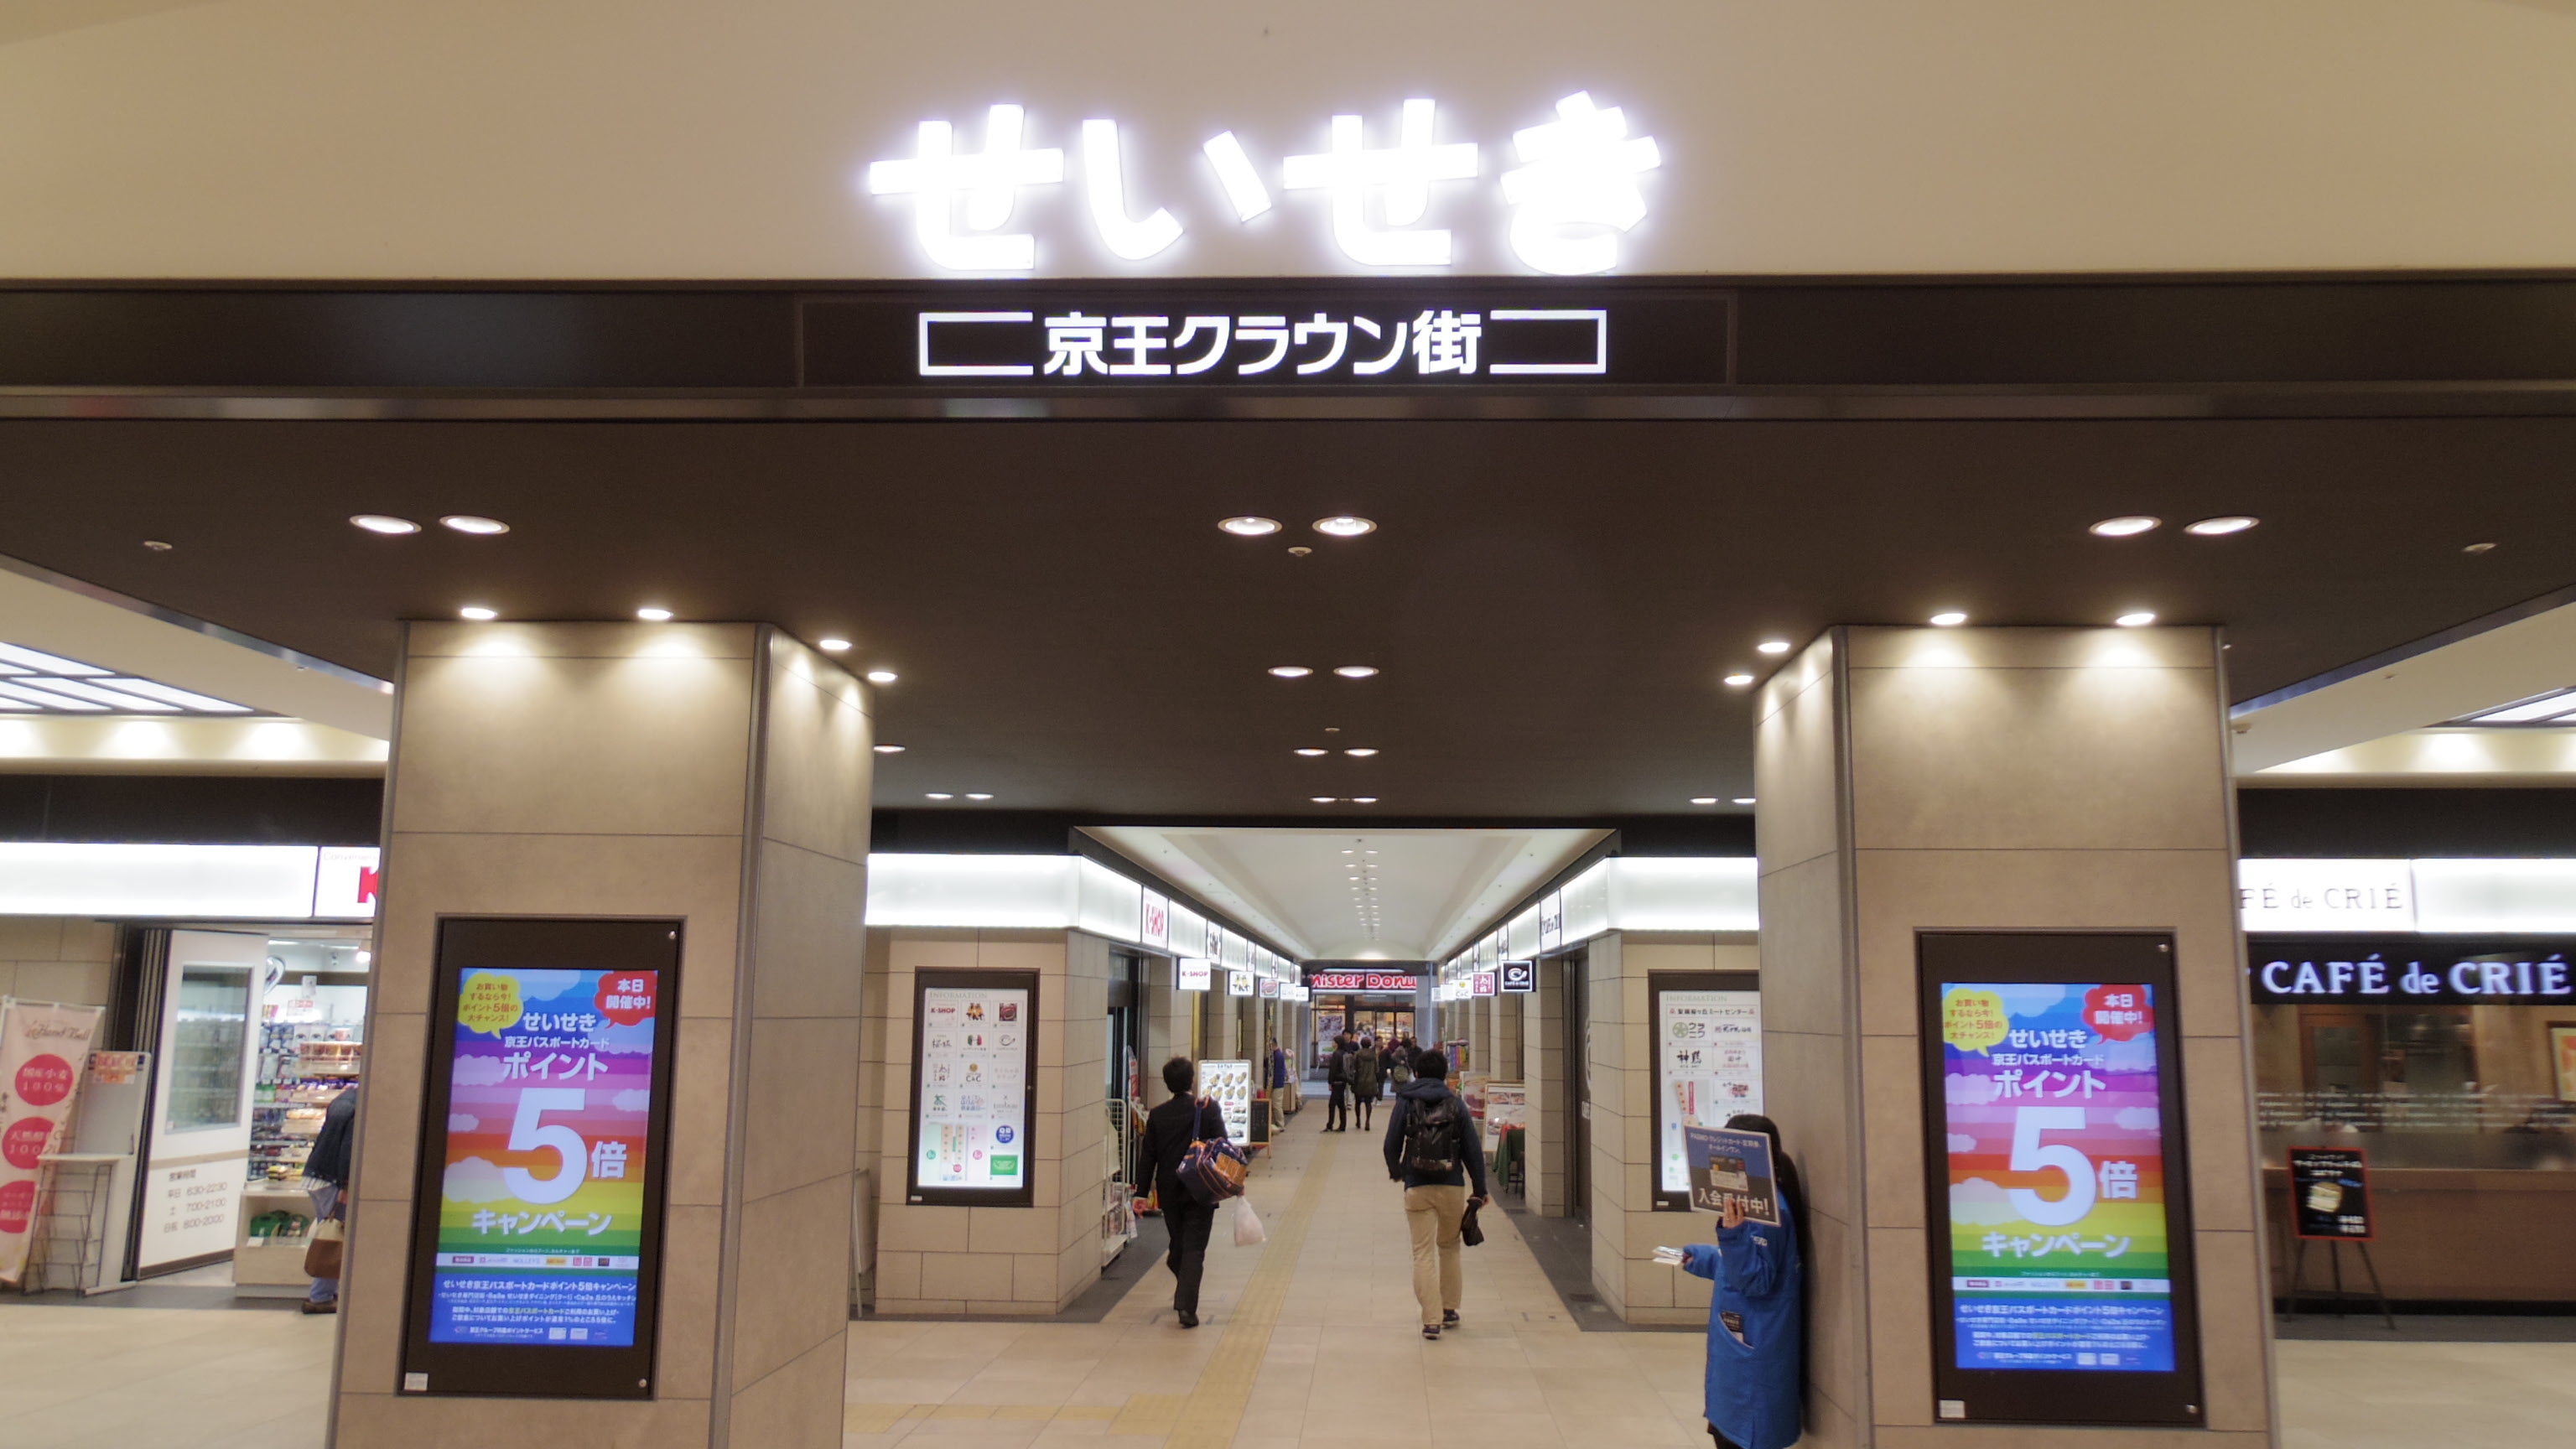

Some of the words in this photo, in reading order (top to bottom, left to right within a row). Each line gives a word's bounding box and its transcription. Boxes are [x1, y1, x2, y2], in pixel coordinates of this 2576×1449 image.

[870, 91, 1661, 275] せいせき
[1043, 309, 1482, 376] 京王クラウン街
[2291, 888, 2313, 909] de
[2324, 883, 2402, 909] CRIÉ
[2262, 953, 2390, 995] CAFÉ
[2401, 962, 2441, 995] de
[2449, 953, 2573, 995] CRIÉ
[617, 978, 644, 993] 本日
[605, 995, 651, 1010] 開催中!
[2104, 994, 2133, 1008] 本日
[522, 1012, 596, 1031] せいせき
[2094, 1010, 2142, 1025] 開催中!
[505, 1036, 610, 1048] 京王パスポートカード
[2009, 1029, 2088, 1048] せいせき
[504, 1051, 609, 1081] ポイント
[1992, 1053, 2104, 1066] 京王パスポートカード
[1993, 1069, 2106, 1098] ポイント
[471, 1210, 612, 1236] キャンペーン
[1981, 1232, 2132, 1258] キャンペーン
